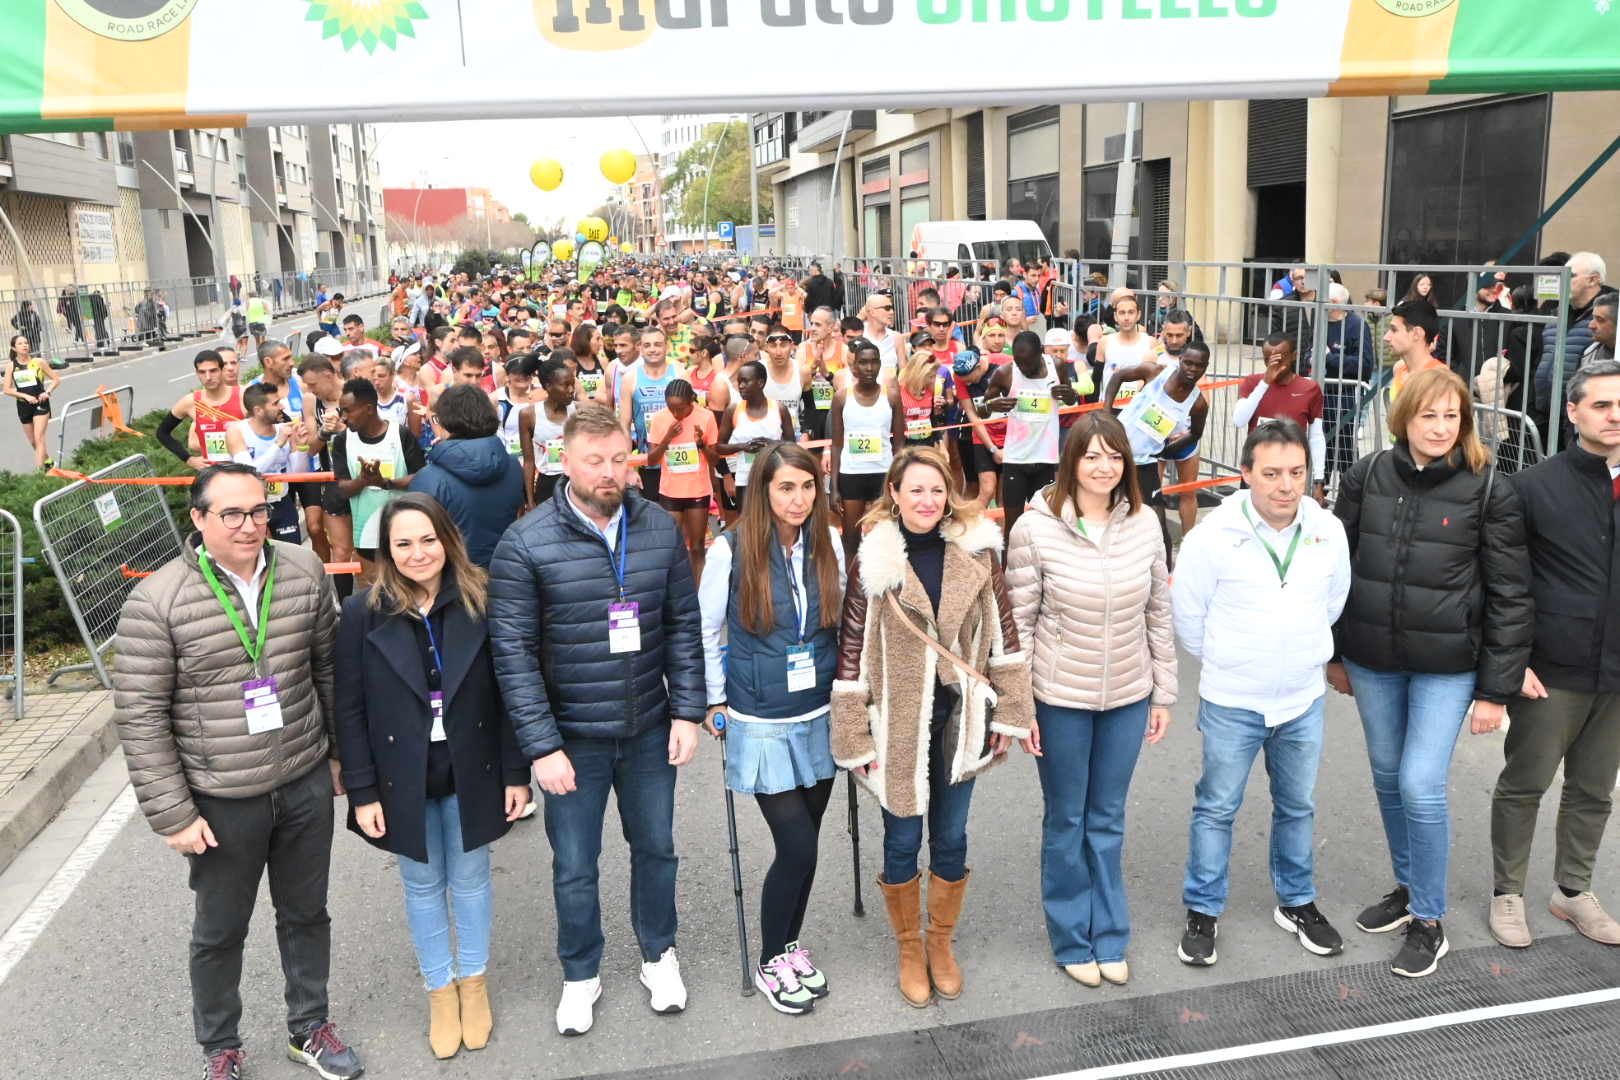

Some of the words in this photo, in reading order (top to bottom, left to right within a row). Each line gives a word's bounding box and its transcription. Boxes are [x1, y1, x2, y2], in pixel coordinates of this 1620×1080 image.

[1396, 0, 1423, 11] ROAD
[107, 22, 144, 33] ROAD
[147, 8, 178, 32] RACE
[720, 223, 730, 237] P
[818, 388, 831, 398] 95
[1031, 398, 1038, 408] 4
[1153, 415, 1163, 426] 3
[213, 439, 225, 450] 12
[857, 438, 871, 450] 22
[674, 450, 688, 462] 20
